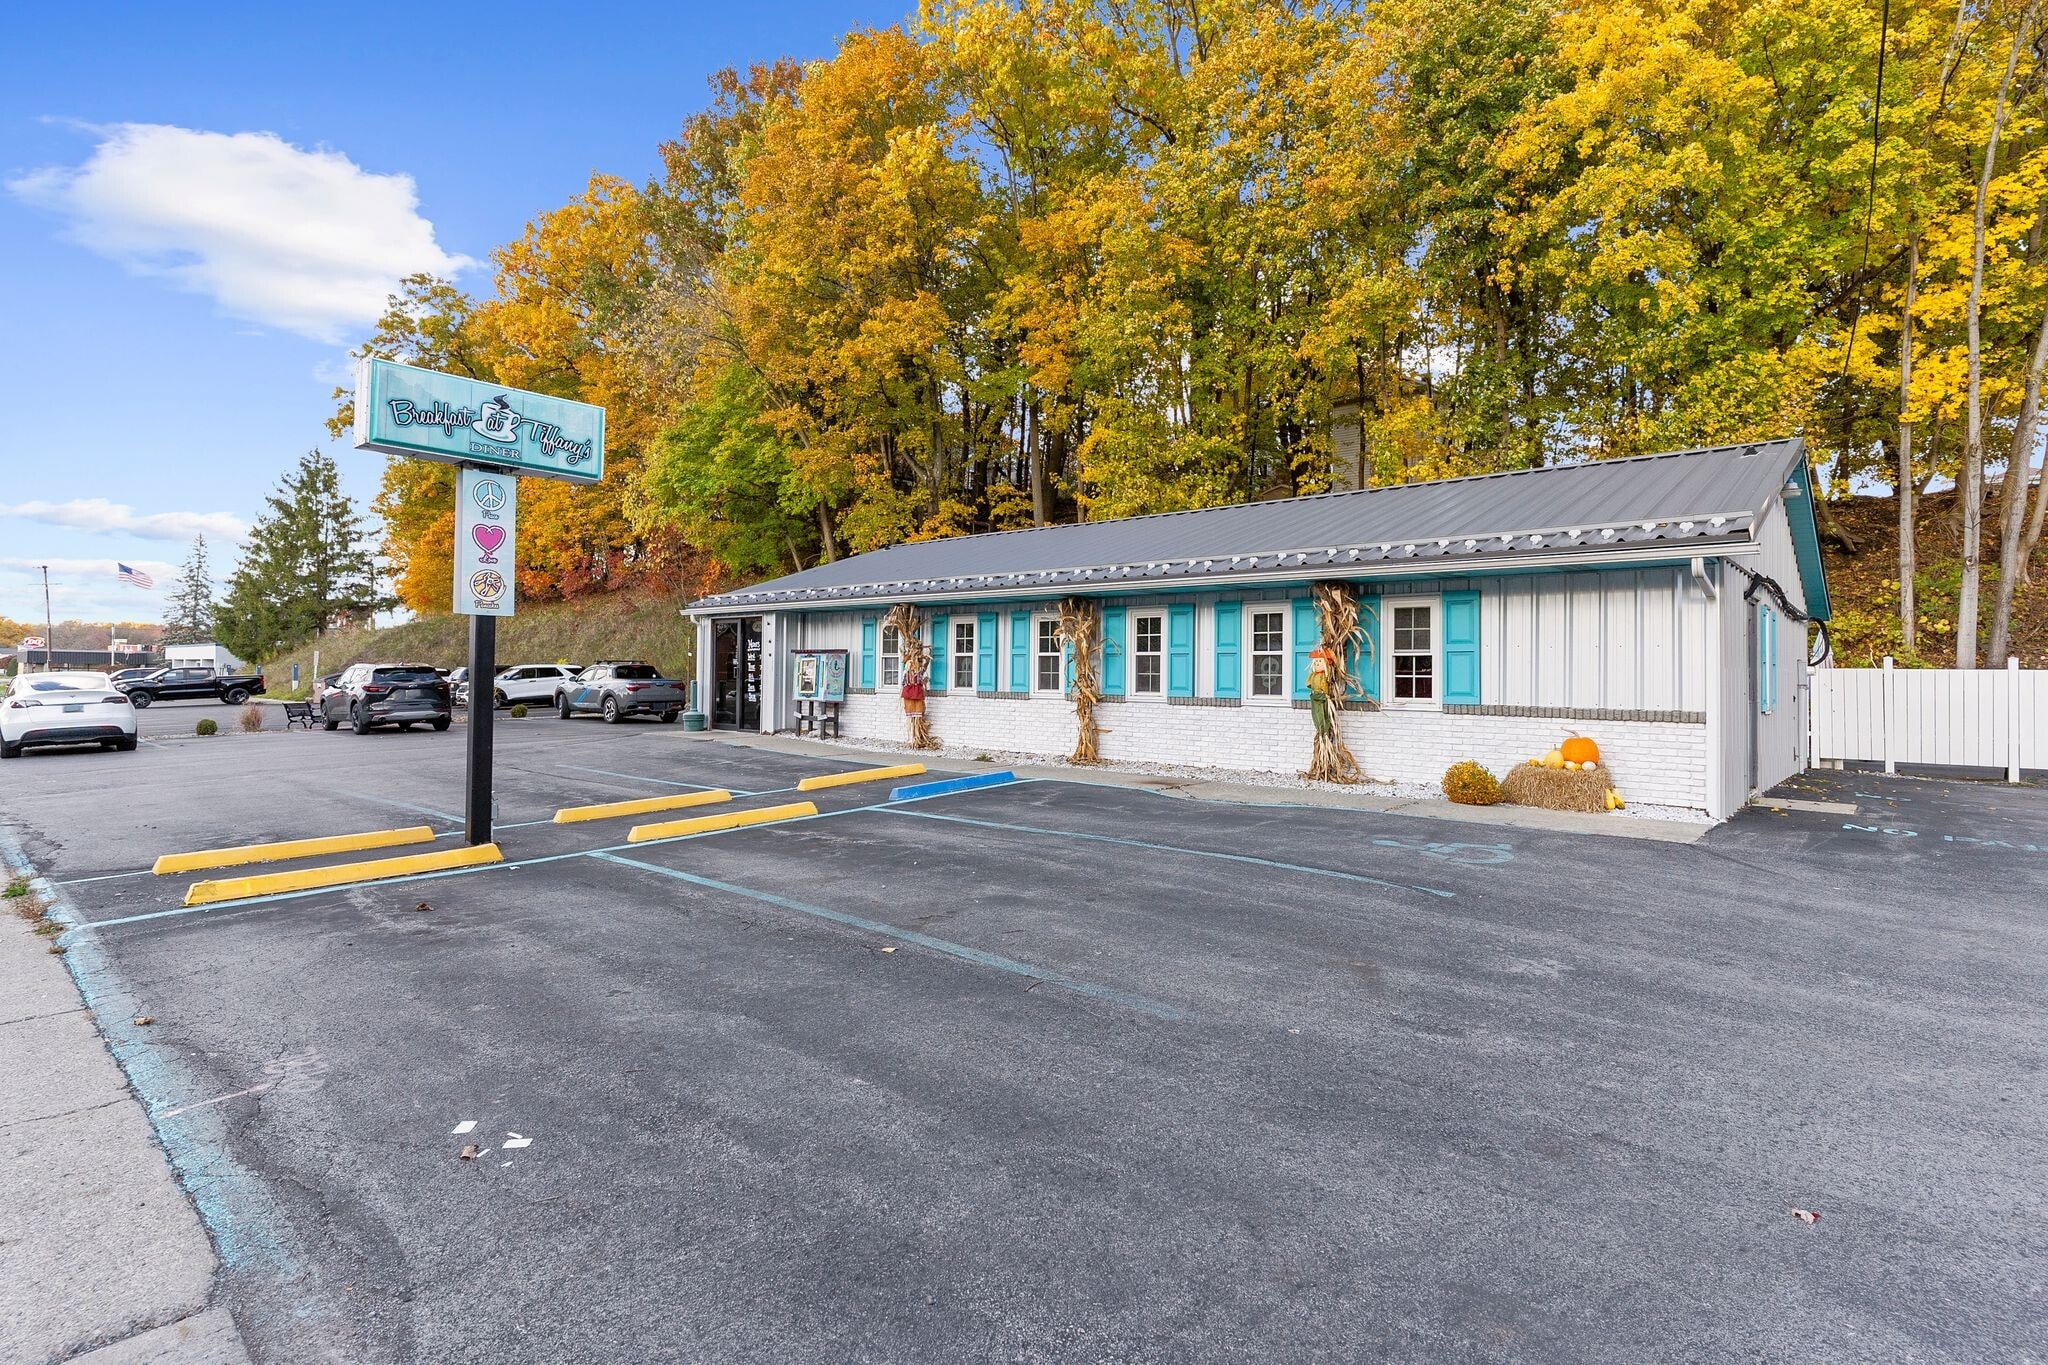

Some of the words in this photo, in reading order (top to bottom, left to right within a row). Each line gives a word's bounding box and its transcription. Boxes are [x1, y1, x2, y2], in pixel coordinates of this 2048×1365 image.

[389, 400, 475, 436] Breakfast
[487, 412, 508, 431] at
[520, 418, 592, 464] Tiffany's
[469, 441, 520, 459] DINER
[1842, 823, 1918, 837] NO
